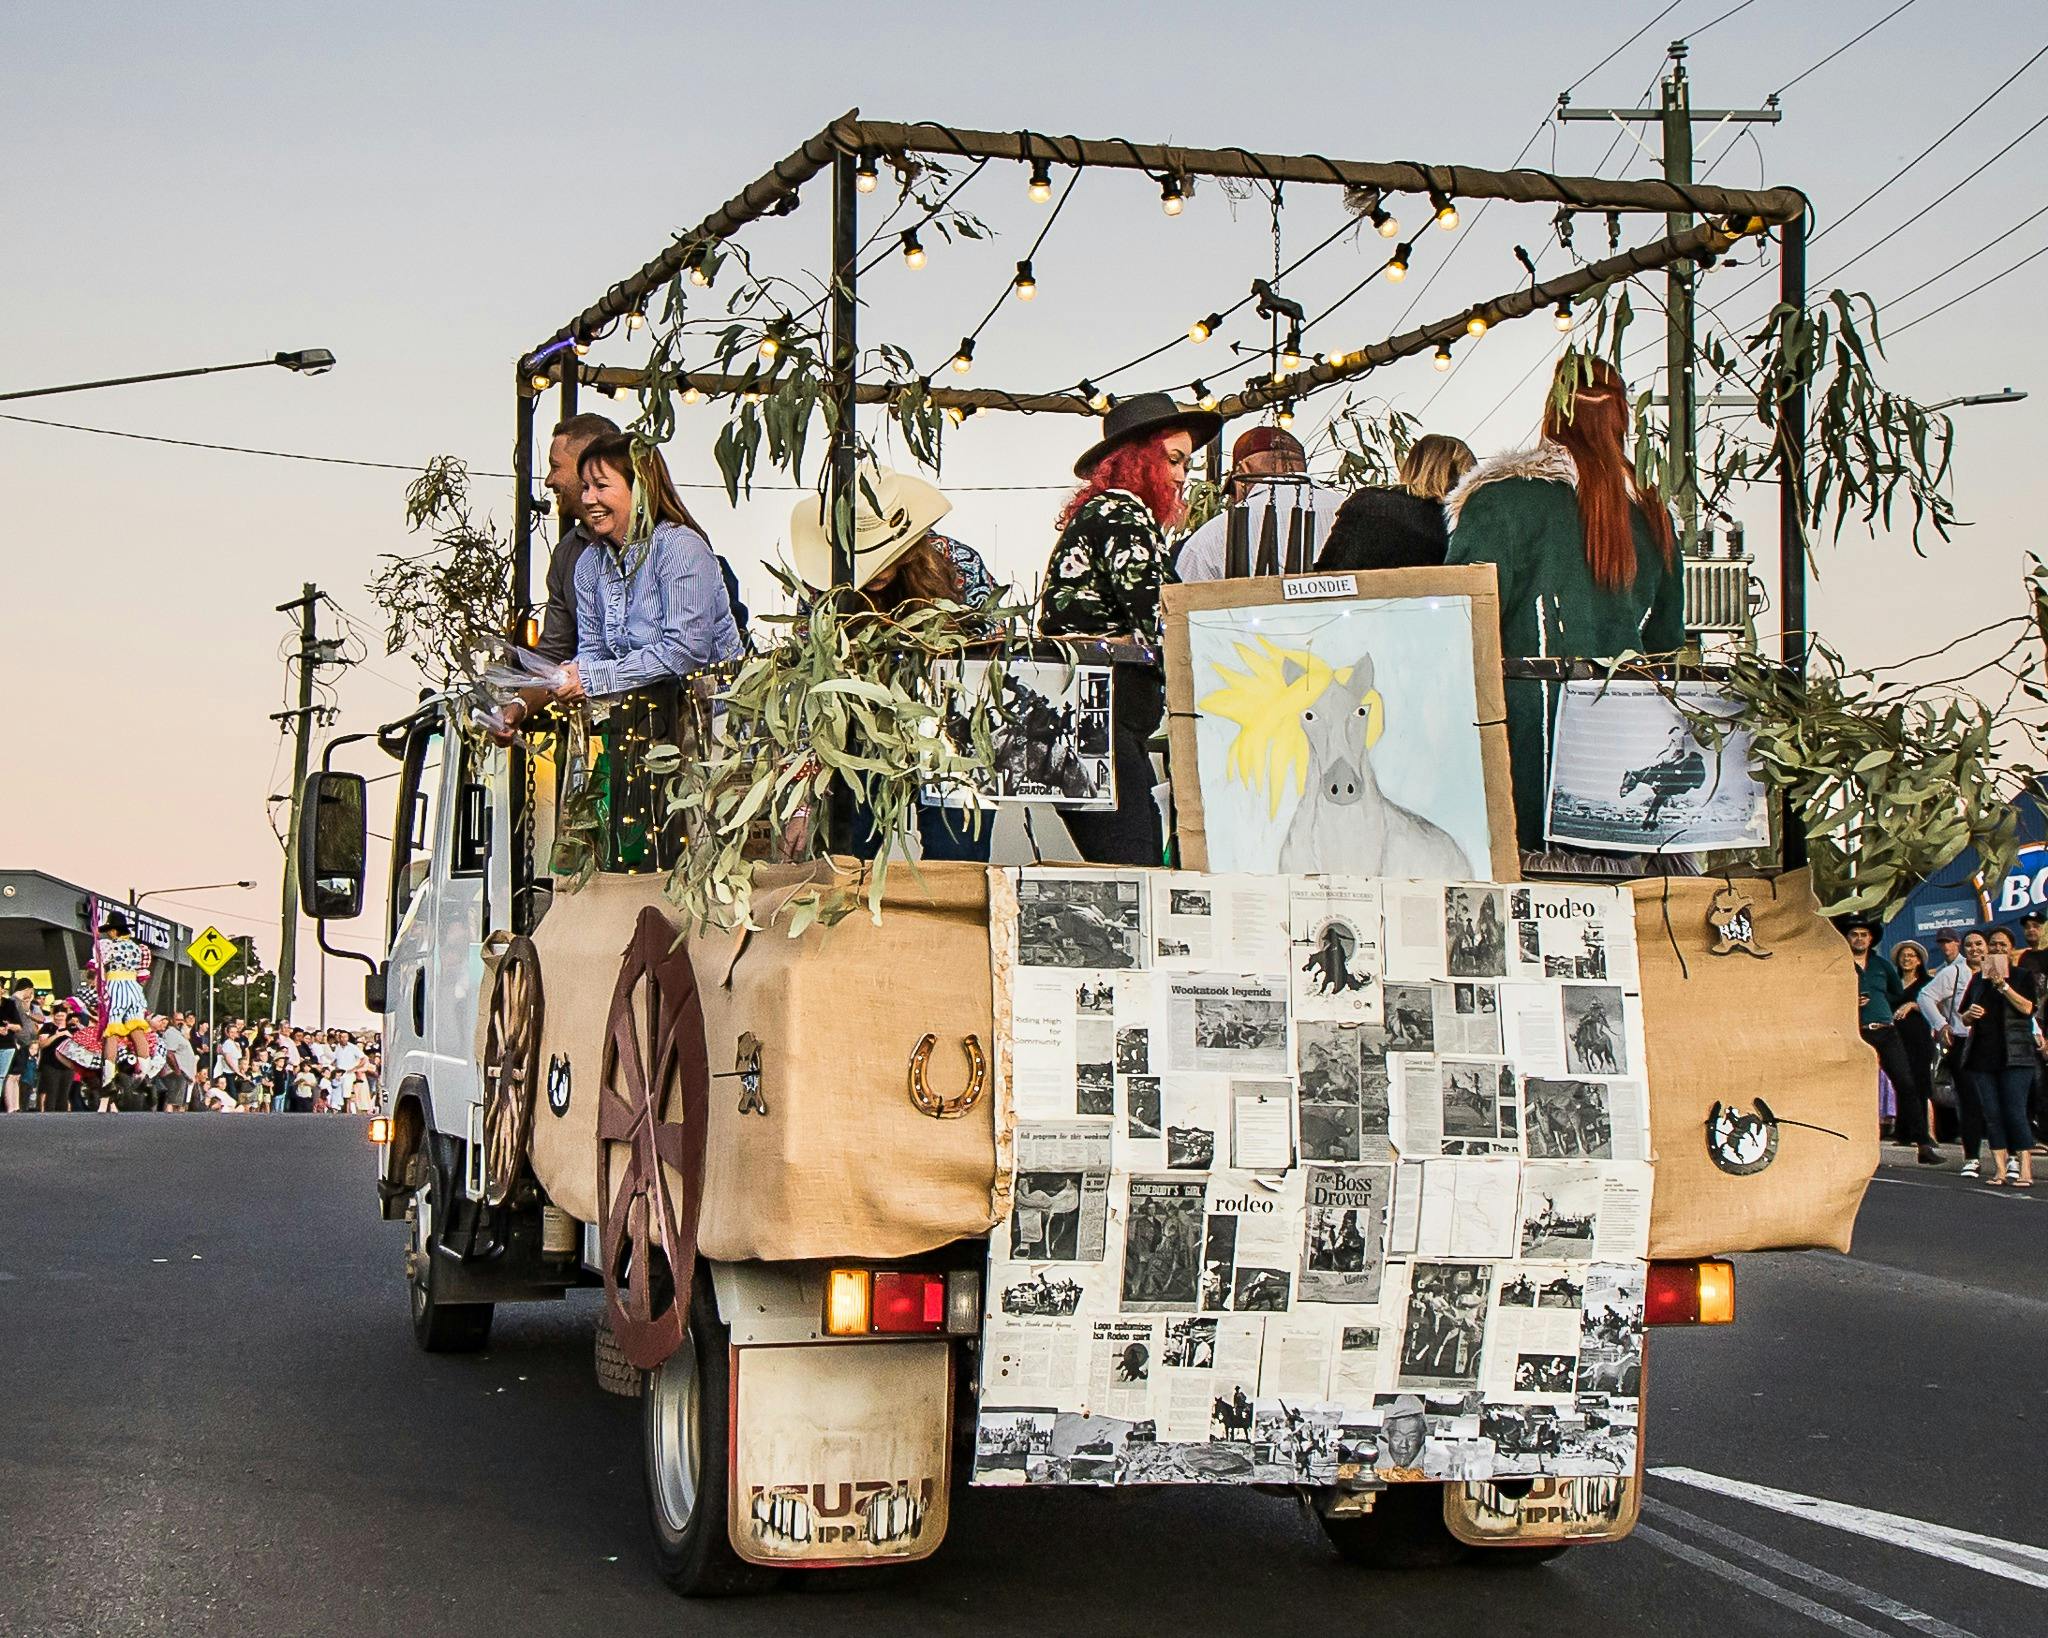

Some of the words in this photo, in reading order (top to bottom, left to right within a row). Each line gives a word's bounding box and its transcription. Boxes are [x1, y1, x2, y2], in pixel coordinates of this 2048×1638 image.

[1287, 579, 1351, 596] BLONDIE
[1534, 897, 1595, 919] rodeo
[1171, 985, 1229, 996] Wookatook
[1232, 986, 1272, 997] legends
[1043, 1017, 1062, 1026] High
[1492, 1144, 1510, 1152] The
[1315, 1172, 1333, 1183] The
[1335, 1173, 1372, 1191] Boss
[1132, 1185, 1179, 1196] SOMEBODY'S
[1314, 1187, 1372, 1206] Drover
[1215, 1194, 1274, 1213] rodeo
[1094, 1321, 1112, 1330] Logo
[1093, 1331, 1104, 1340] Isa
[1107, 1332, 1130, 1340] Rodeo
[752, 1478, 933, 1519] IUZ
